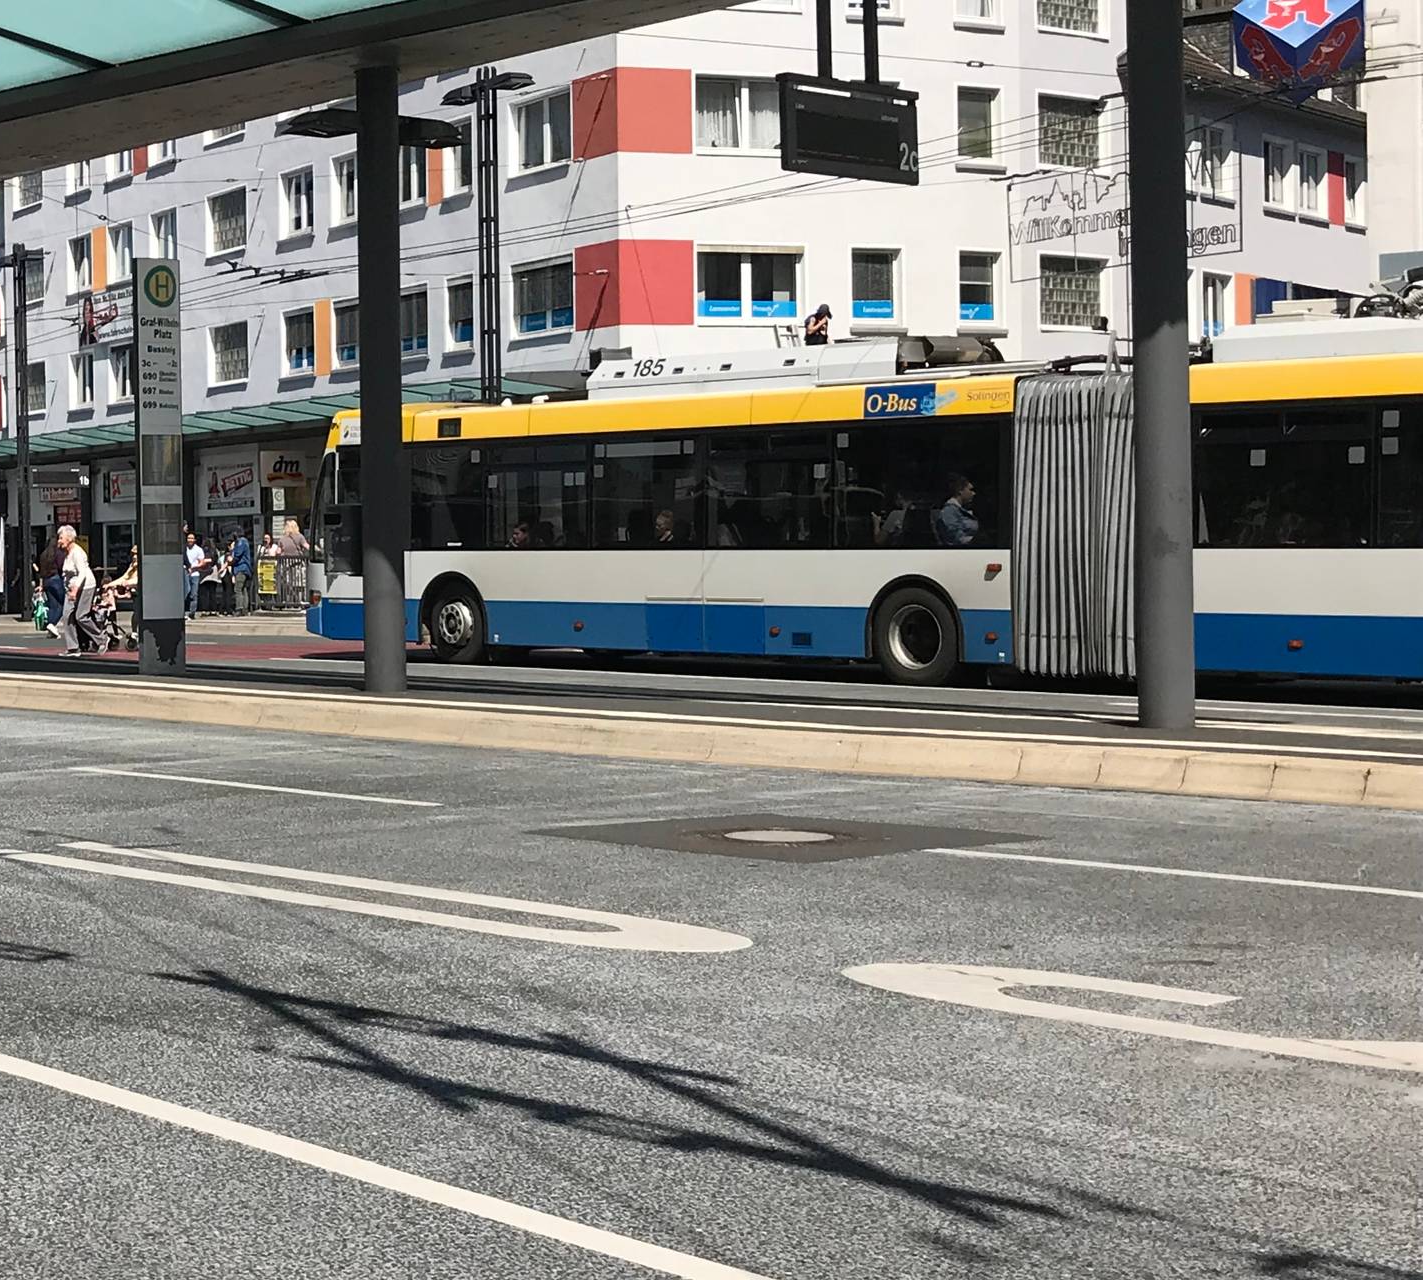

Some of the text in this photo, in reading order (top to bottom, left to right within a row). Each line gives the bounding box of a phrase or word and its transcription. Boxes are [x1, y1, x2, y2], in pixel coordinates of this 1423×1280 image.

[899, 142, 919, 172] 2c
[153, 329, 173, 340] Platz
[147, 345, 176, 356] Bussteig
[633, 359, 667, 378] 185
[866, 391, 1011, 414] O-Bus Solingen
[273, 456, 300, 473] dm
[79, 475, 90, 486] 1b
